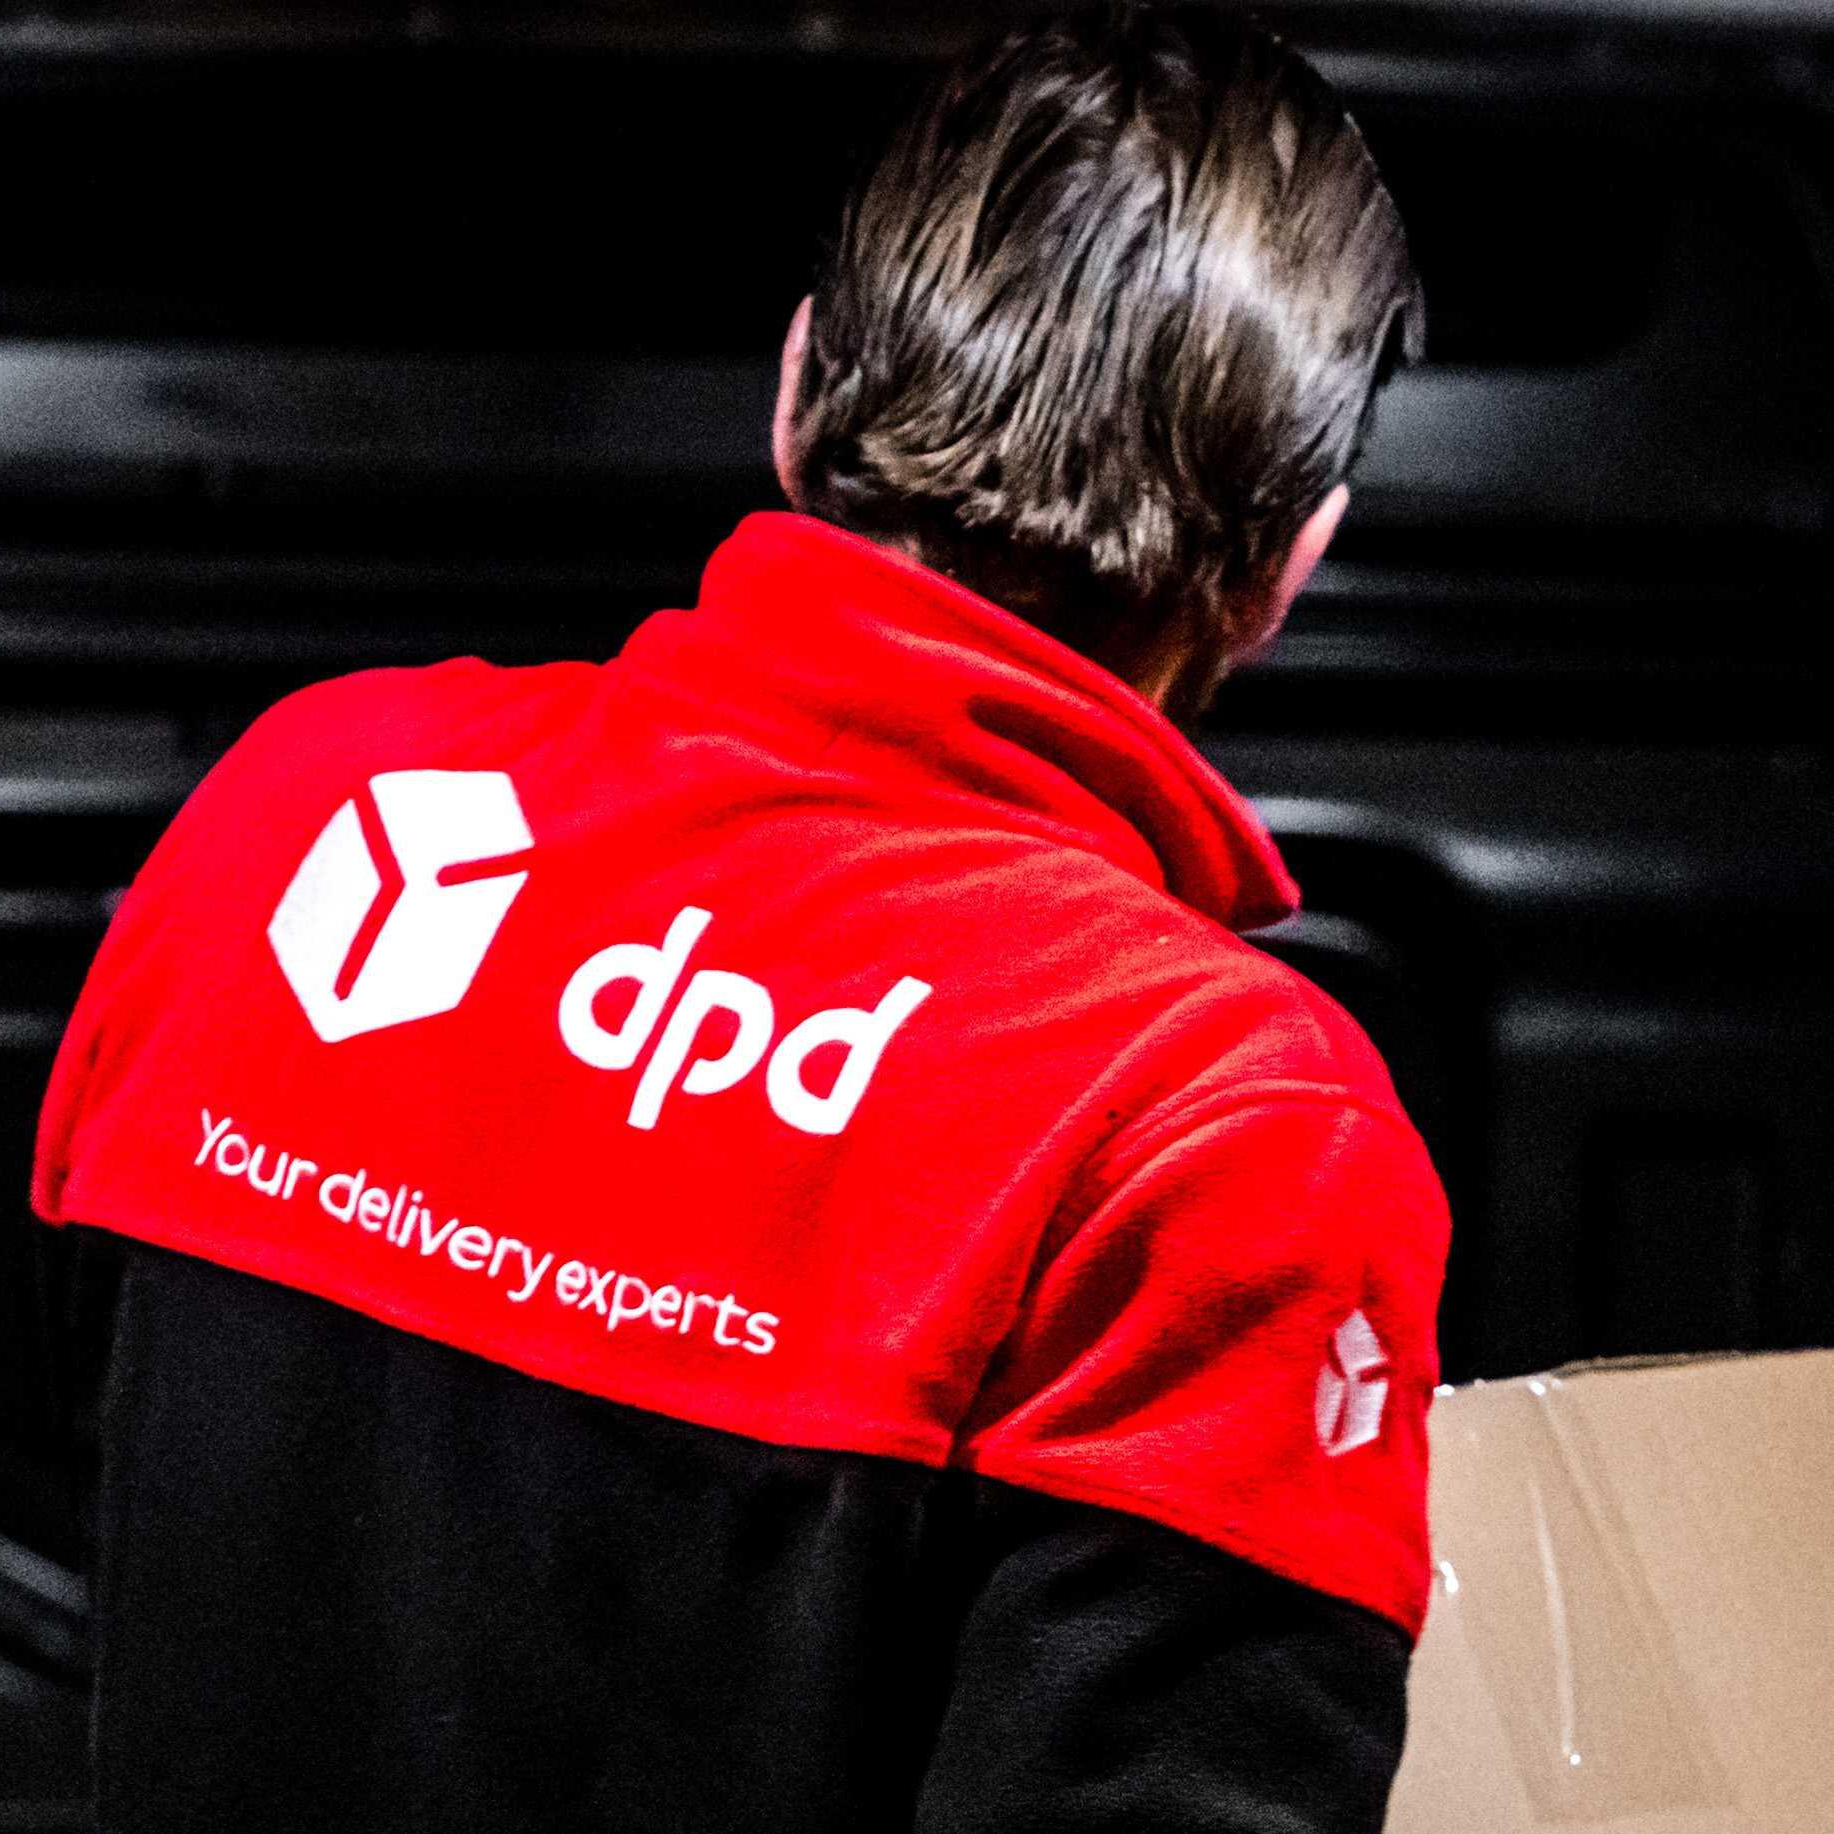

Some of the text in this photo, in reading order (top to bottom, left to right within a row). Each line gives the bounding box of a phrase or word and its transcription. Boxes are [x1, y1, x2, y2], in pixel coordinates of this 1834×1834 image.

[558, 905, 933, 1135] dpd
[194, 1108, 780, 1355] Your delivery experts
